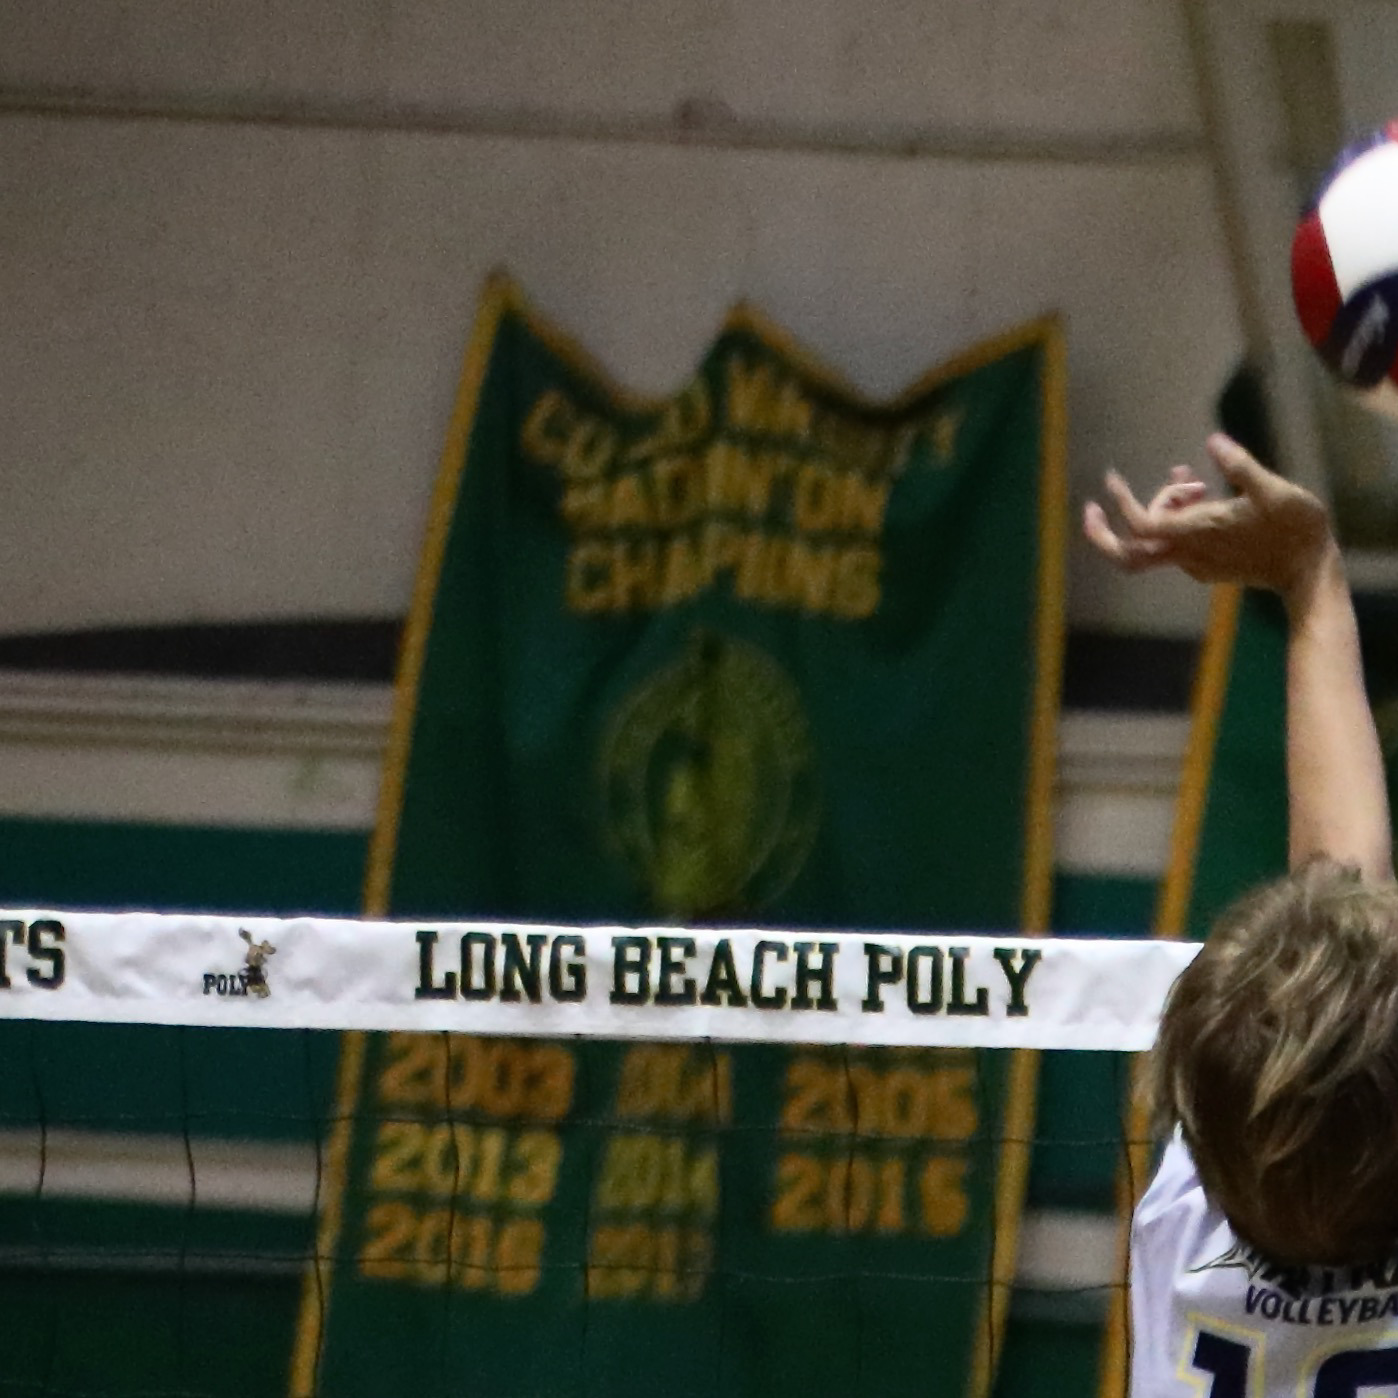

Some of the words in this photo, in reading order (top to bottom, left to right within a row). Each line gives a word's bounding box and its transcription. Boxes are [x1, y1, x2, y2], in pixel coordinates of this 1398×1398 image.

[414, 930, 588, 1004] LONG
[609, 935, 840, 1012] BEACH
[861, 943, 1043, 1018] POLY
[371, 1119, 563, 1206] 2013
